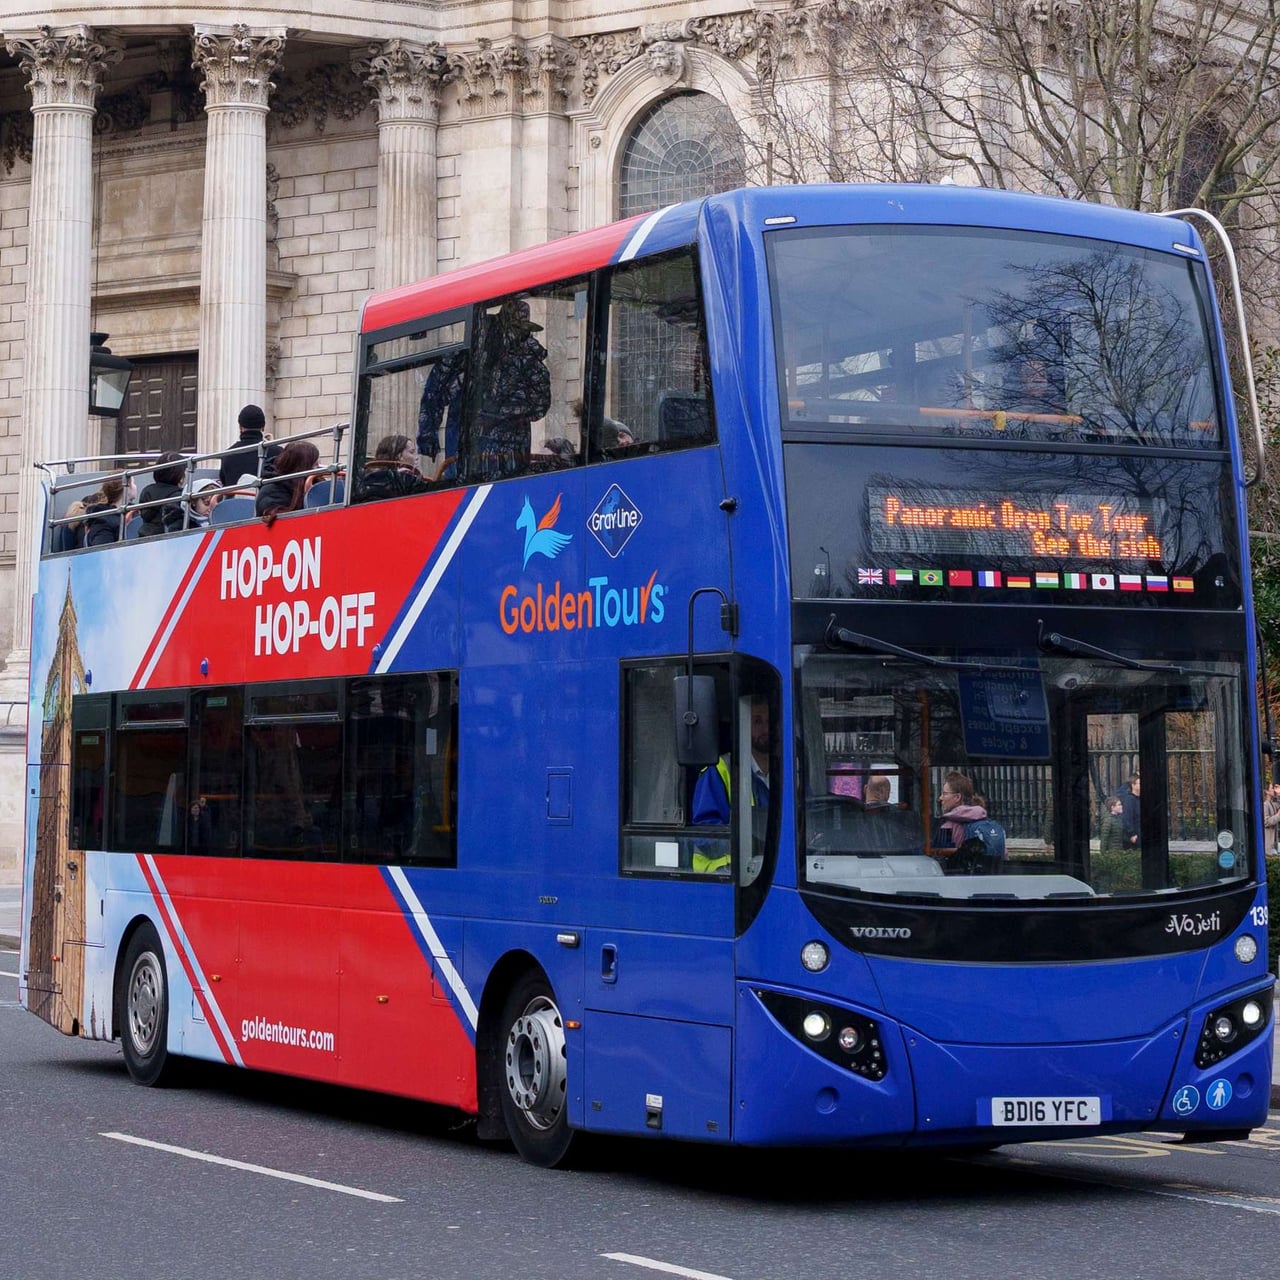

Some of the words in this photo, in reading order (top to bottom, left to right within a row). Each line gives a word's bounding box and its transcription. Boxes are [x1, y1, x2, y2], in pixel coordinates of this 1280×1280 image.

[885, 496, 996, 528] Panoramic
[1098, 505, 1148, 533] Tour
[1033, 531, 1071, 555] See
[1077, 533, 1111, 556] the
[220, 535, 322, 600] HOP-ON
[254, 591, 376, 657] HOP-OFF
[850, 925, 912, 940] VOLVO
[241, 1017, 335, 1053] goldentours.com
[1003, 1100, 1045, 1122] BD16
[1052, 1100, 1088, 1122] YFC
